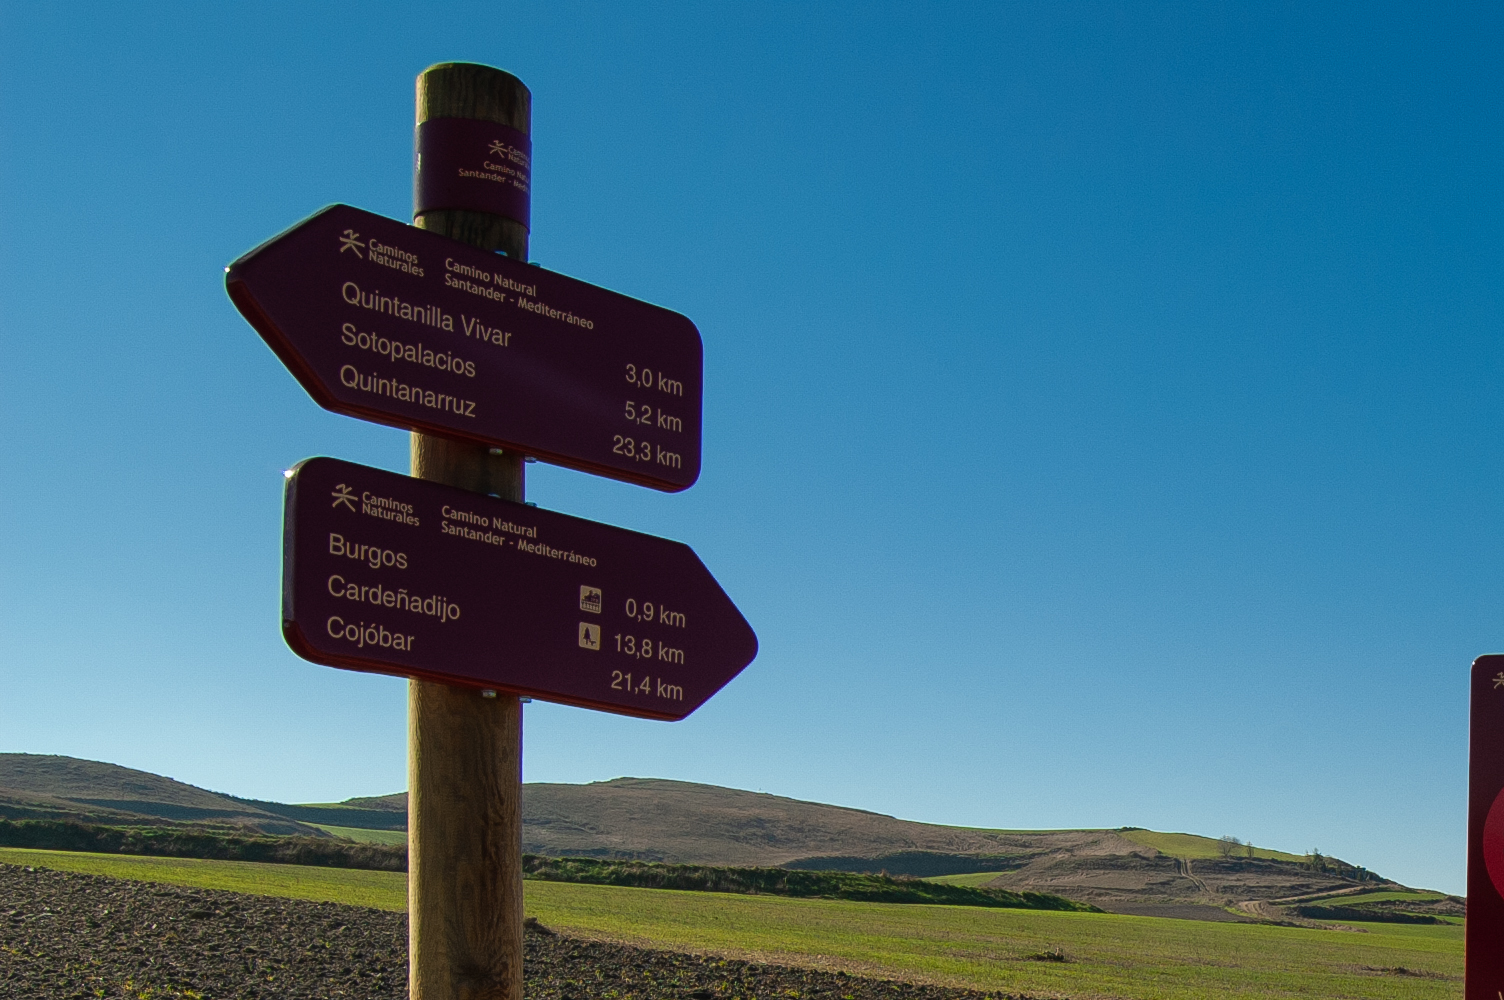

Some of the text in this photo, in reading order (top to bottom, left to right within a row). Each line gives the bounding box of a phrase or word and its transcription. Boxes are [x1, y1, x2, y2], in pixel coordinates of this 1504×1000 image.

[458, 168, 506, 183] Santander
[483, 161, 515, 176] Camino
[369, 239, 417, 265] Caminos
[369, 251, 424, 276] Naturales
[446, 258, 535, 296] Camino Natural
[445, 274, 505, 302] Santander
[518, 297, 593, 329] Mediterráneo
[342, 282, 682, 396] Quintanilla Vivar 3,0 km
[342, 323, 681, 432] Sotopalacios 5,2 km
[341, 365, 680, 468] Quintanarruz 23,3 km
[363, 492, 413, 514] Caminos
[363, 503, 419, 526] Naturales
[442, 506, 536, 538] Camino Natural
[442, 521, 505, 545] Santander
[518, 539, 596, 567] Mediterráneo
[330, 533, 685, 627] Burgos 0,9 km
[328, 575, 683, 664] Cardeñadijo 13,8 km
[327, 616, 682, 700] Cojóbar 21,4 km
